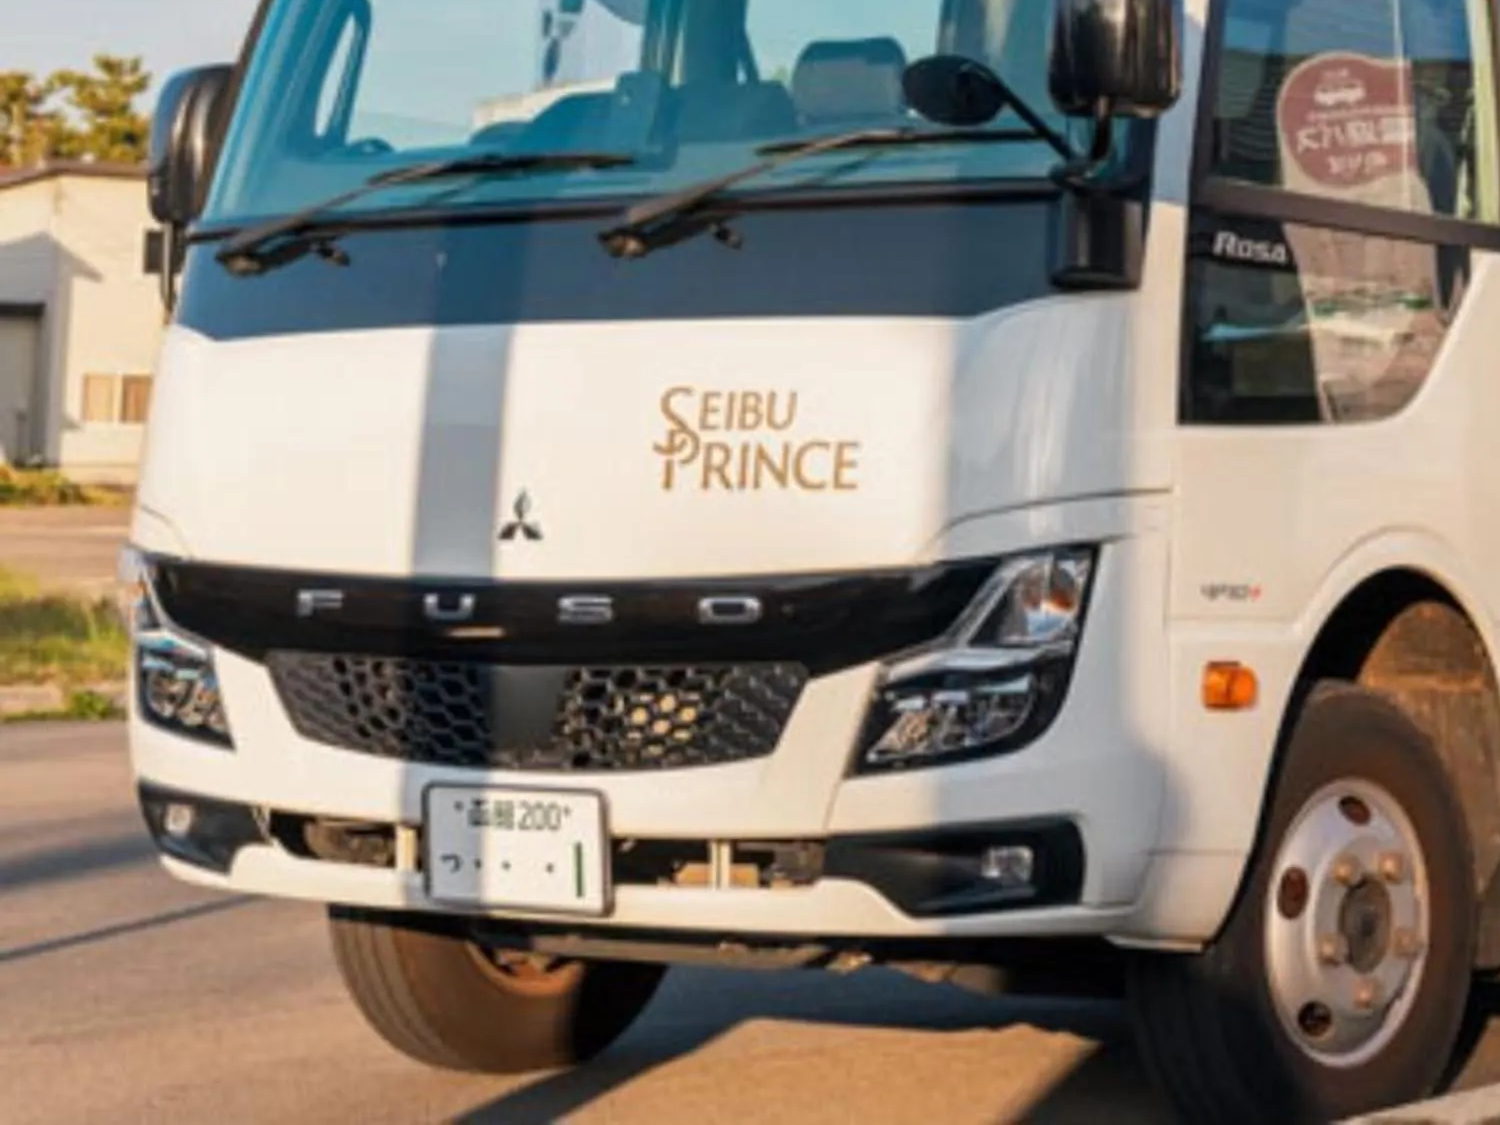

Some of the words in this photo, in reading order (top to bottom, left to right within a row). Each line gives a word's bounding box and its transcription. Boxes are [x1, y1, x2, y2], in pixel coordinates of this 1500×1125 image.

[653, 384, 798, 455] SEIBU
[662, 427, 861, 491] PRINCE
[296, 588, 763, 625] FUSO
